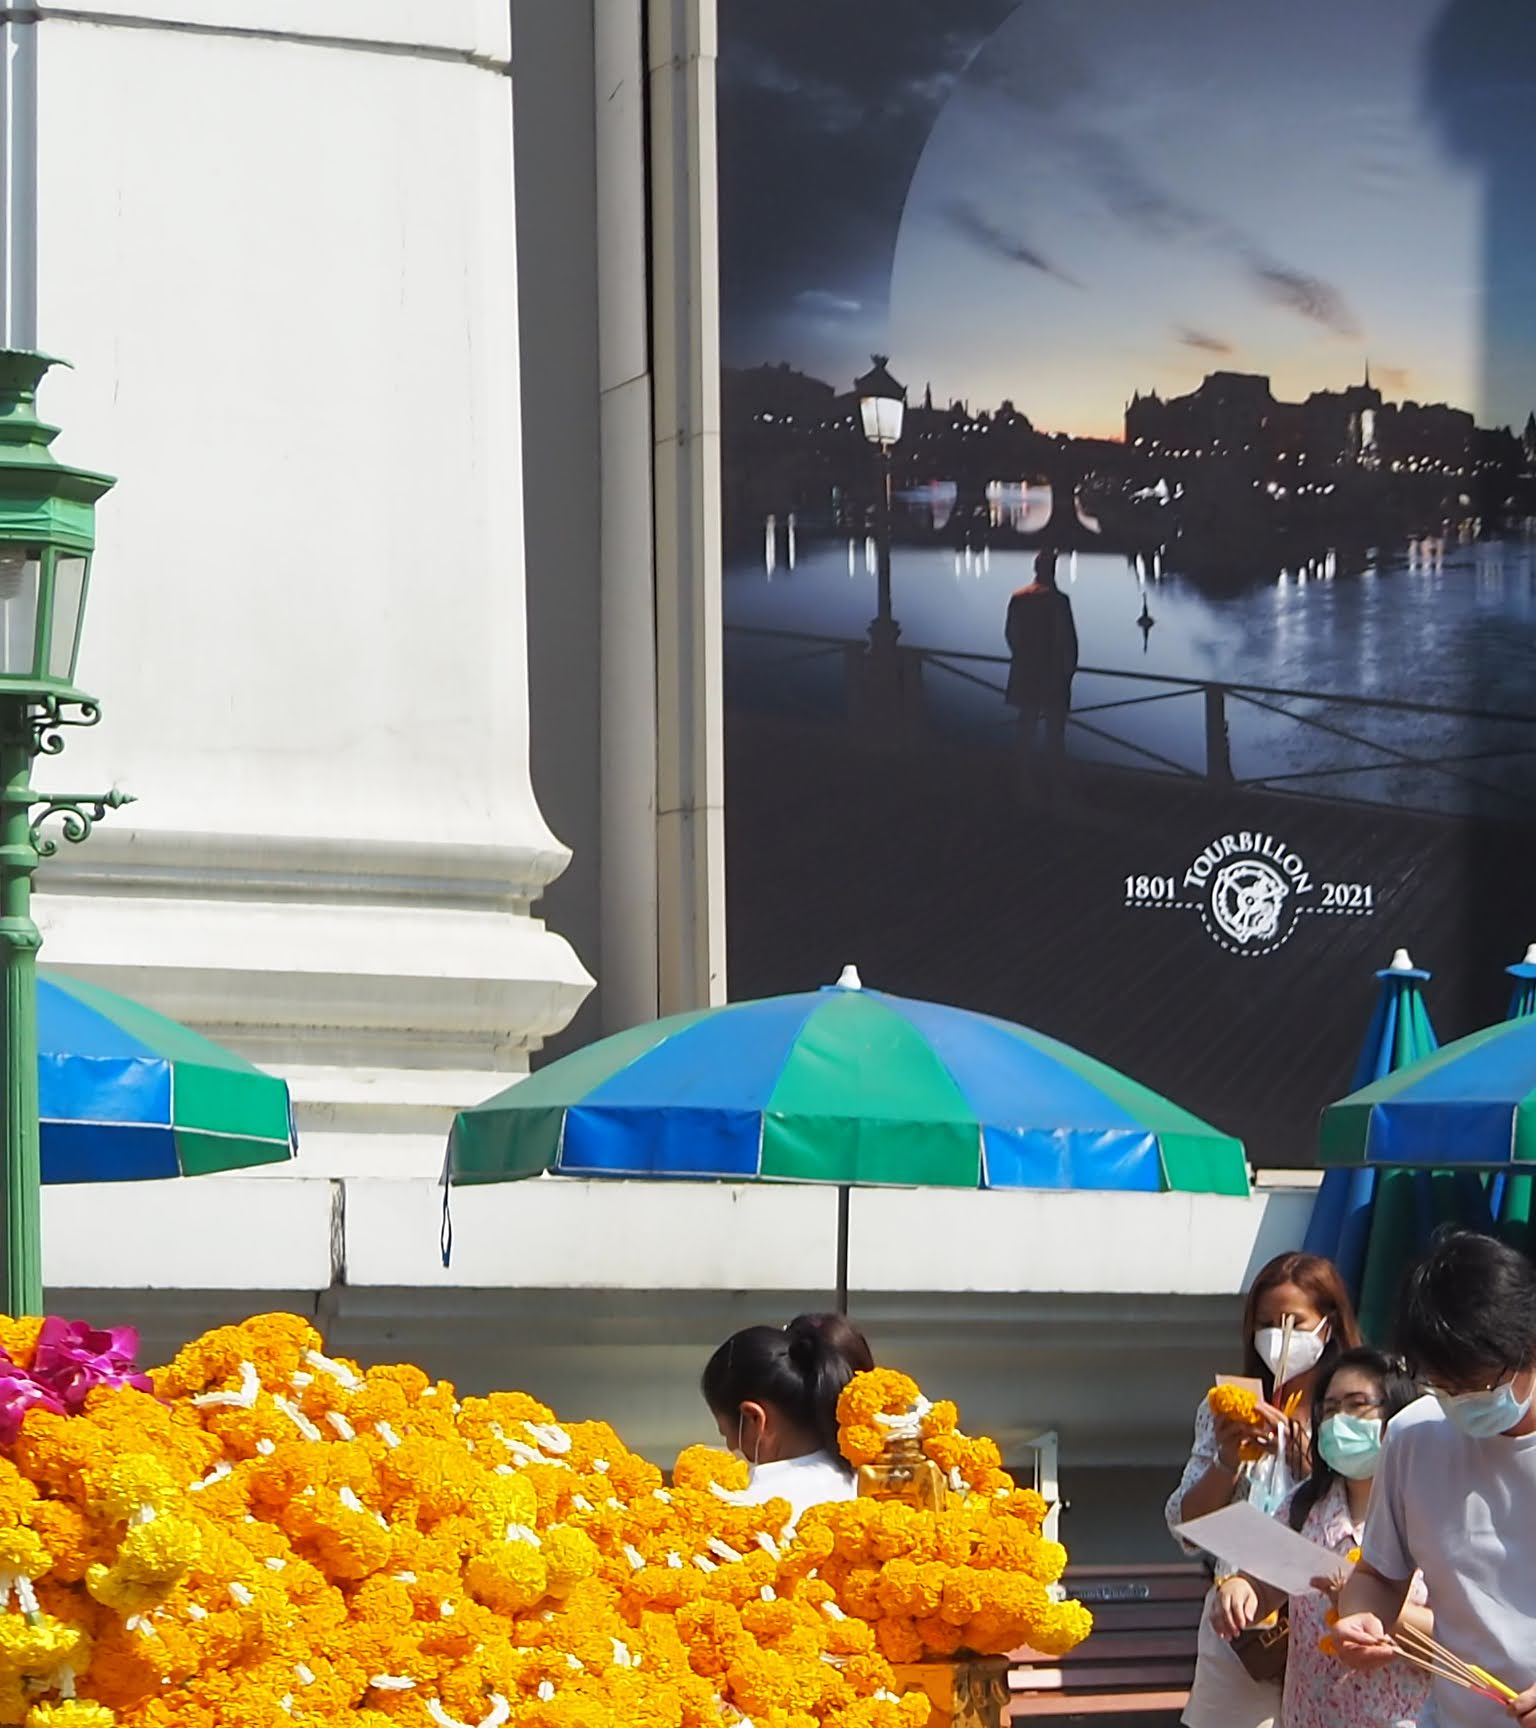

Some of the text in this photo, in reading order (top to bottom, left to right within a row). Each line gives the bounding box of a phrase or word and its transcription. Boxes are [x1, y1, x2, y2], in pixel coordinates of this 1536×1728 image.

[1184, 831, 1314, 895] TOURBILLON
[1124, 874, 1176, 900] 1801
[1321, 882, 1375, 907] 2021
